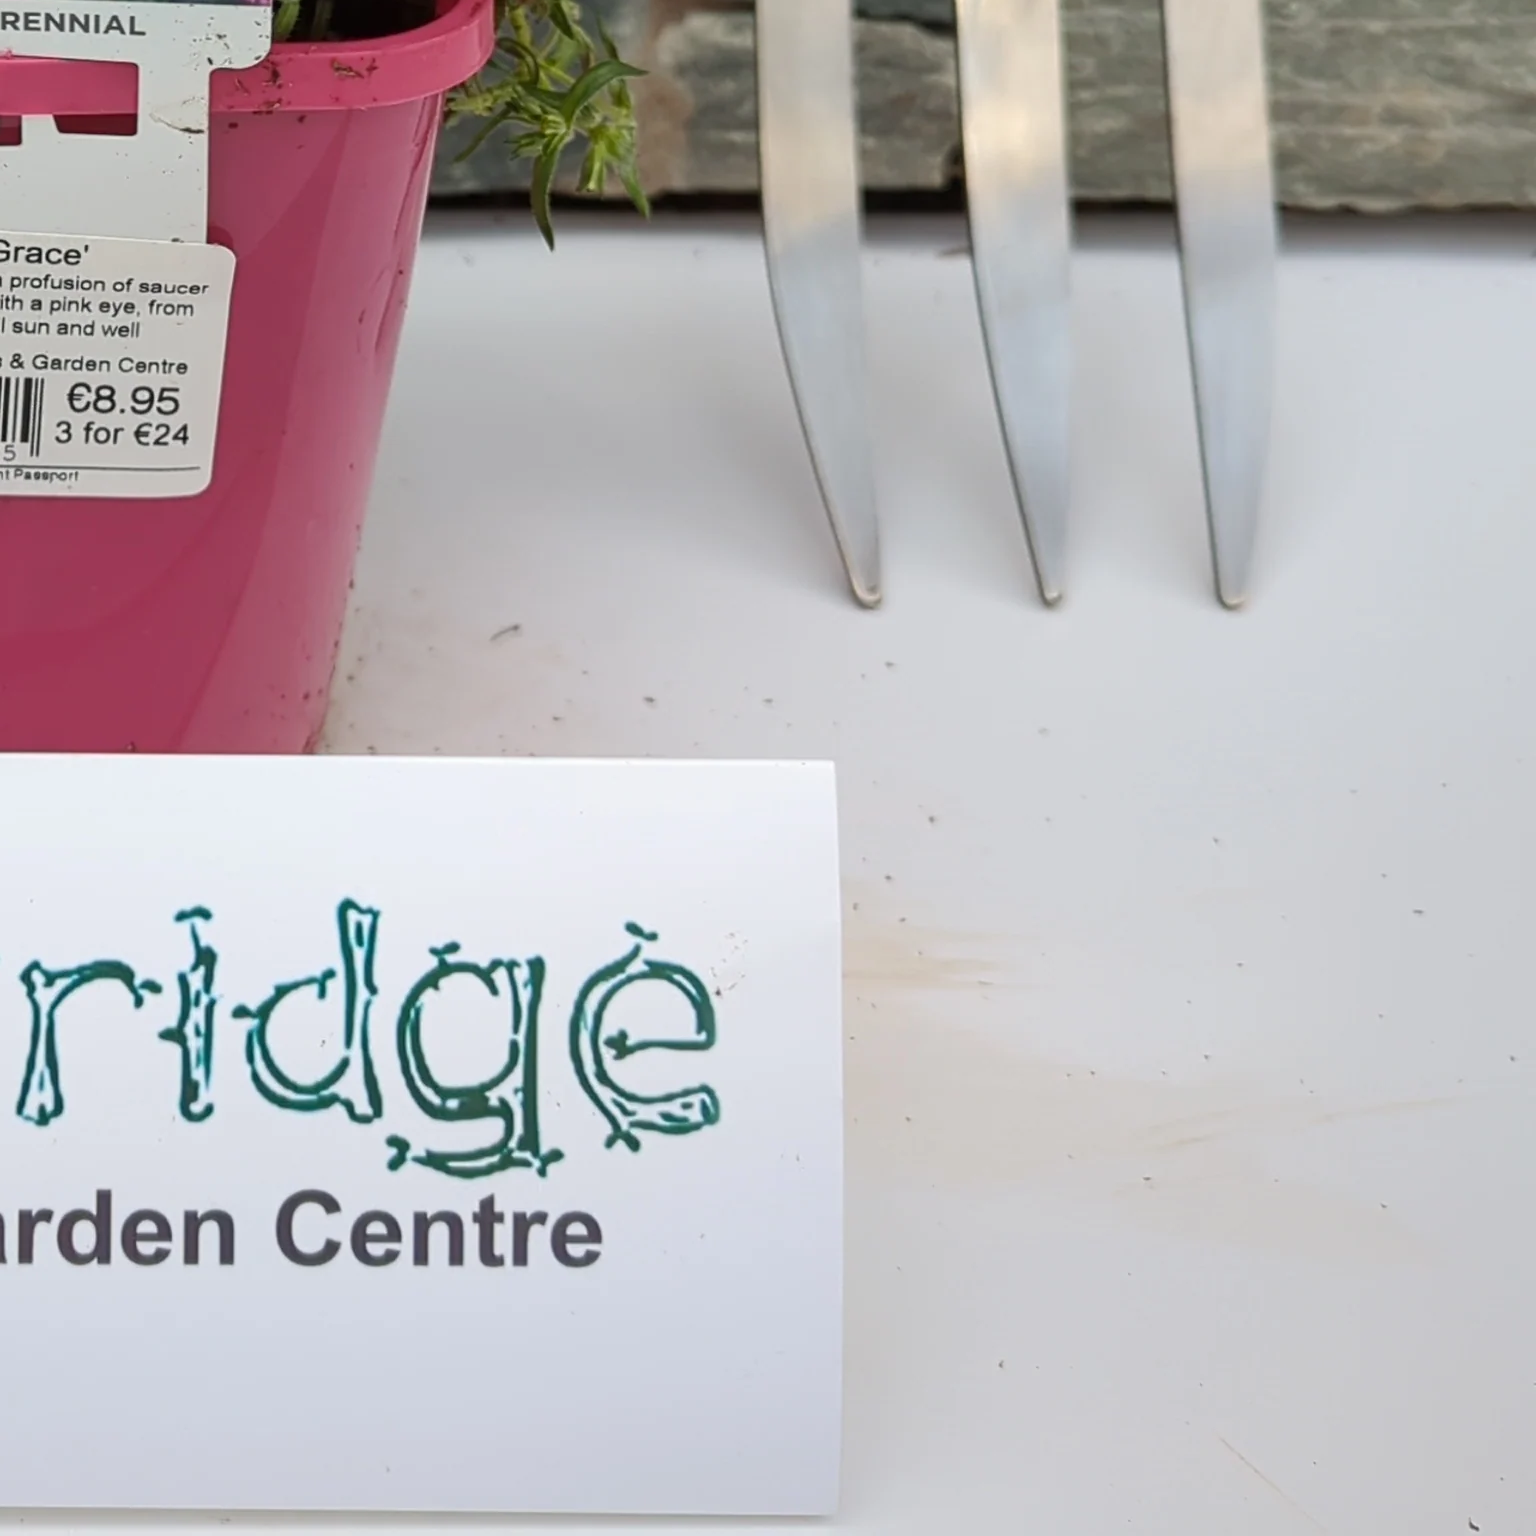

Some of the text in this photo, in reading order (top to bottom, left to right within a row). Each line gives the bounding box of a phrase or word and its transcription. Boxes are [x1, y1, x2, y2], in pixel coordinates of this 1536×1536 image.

[10, 273, 106, 292] profusion
[112, 278, 135, 293] of
[138, 282, 210, 295] saucer
[30, 298, 42, 312] a
[50, 296, 92, 315] pink
[98, 301, 141, 318] eye,
[147, 299, 194, 317] from
[12, 320, 50, 335] sun
[56, 319, 95, 337] and
[101, 321, 141, 338] well
[10, 353, 25, 370] &
[32, 354, 111, 372] Garden
[117, 357, 188, 375] Centre
[66, 382, 181, 416] €8.95
[54, 421, 190, 447] 3 for €24
[14, 469, 79, 484] Passport
[275, 1189, 604, 1268] Centre
